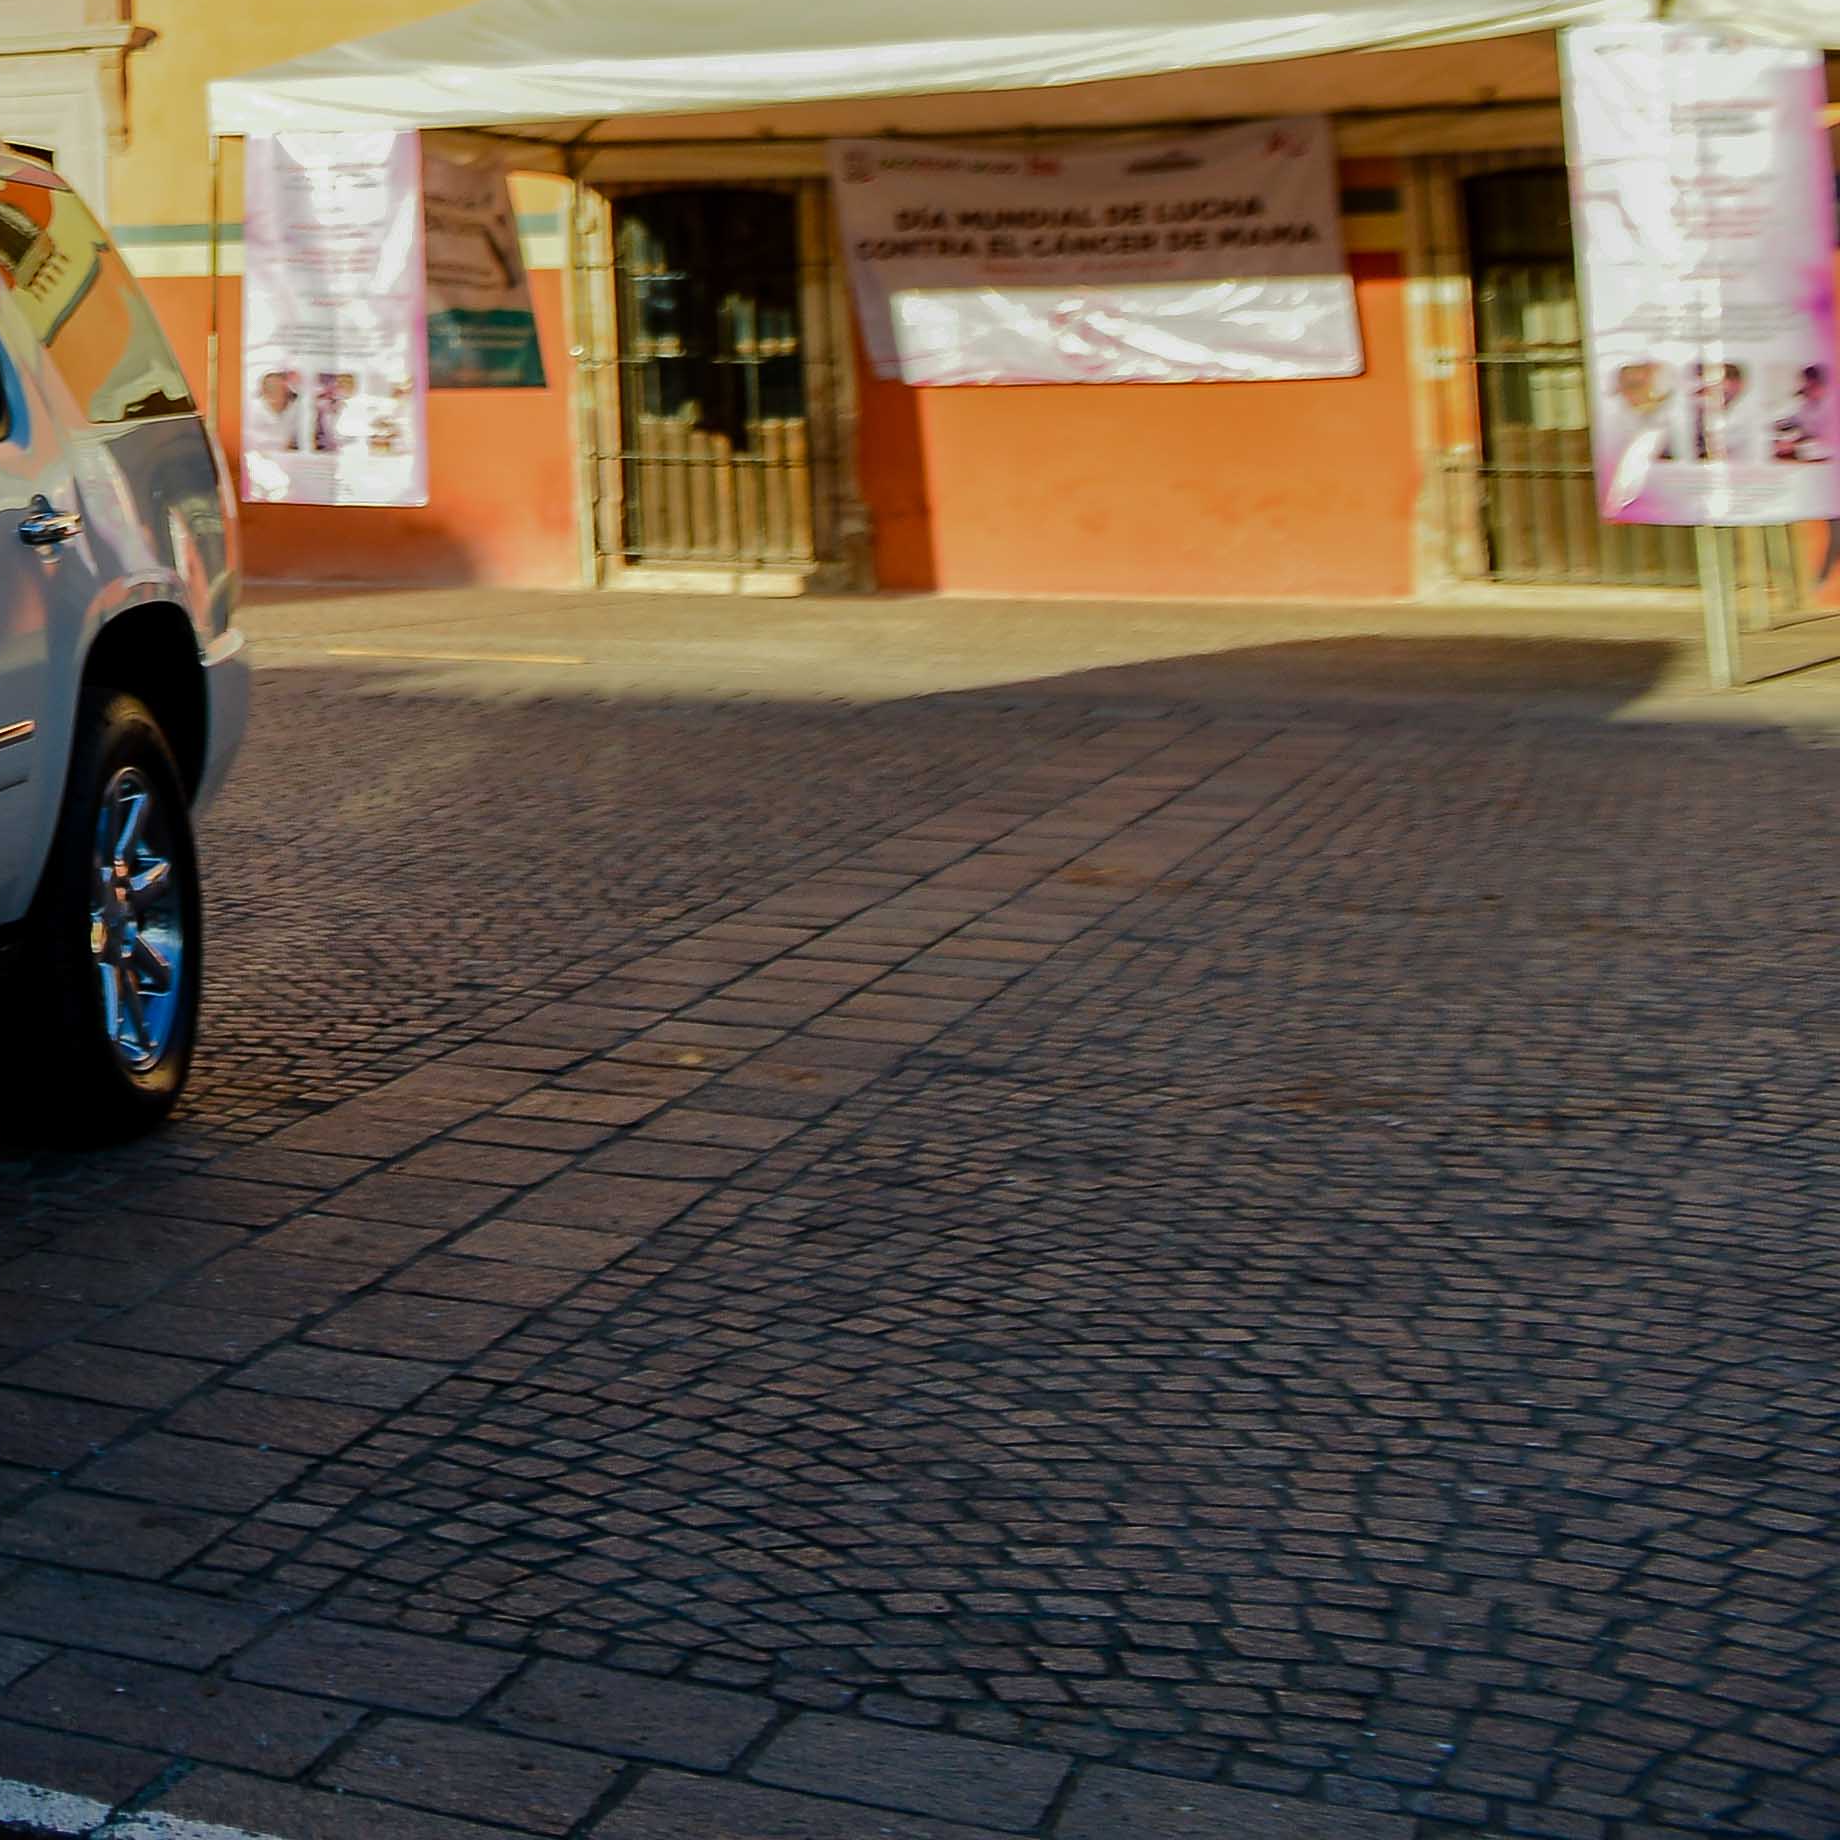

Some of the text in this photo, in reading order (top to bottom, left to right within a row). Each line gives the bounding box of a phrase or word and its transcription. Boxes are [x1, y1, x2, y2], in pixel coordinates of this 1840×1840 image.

[895, 196, 1263, 232] DÍA MUNDIAL DE LUCHA
[856, 222, 1318, 261] CONTRA EL CÁNCER DE MAMA
